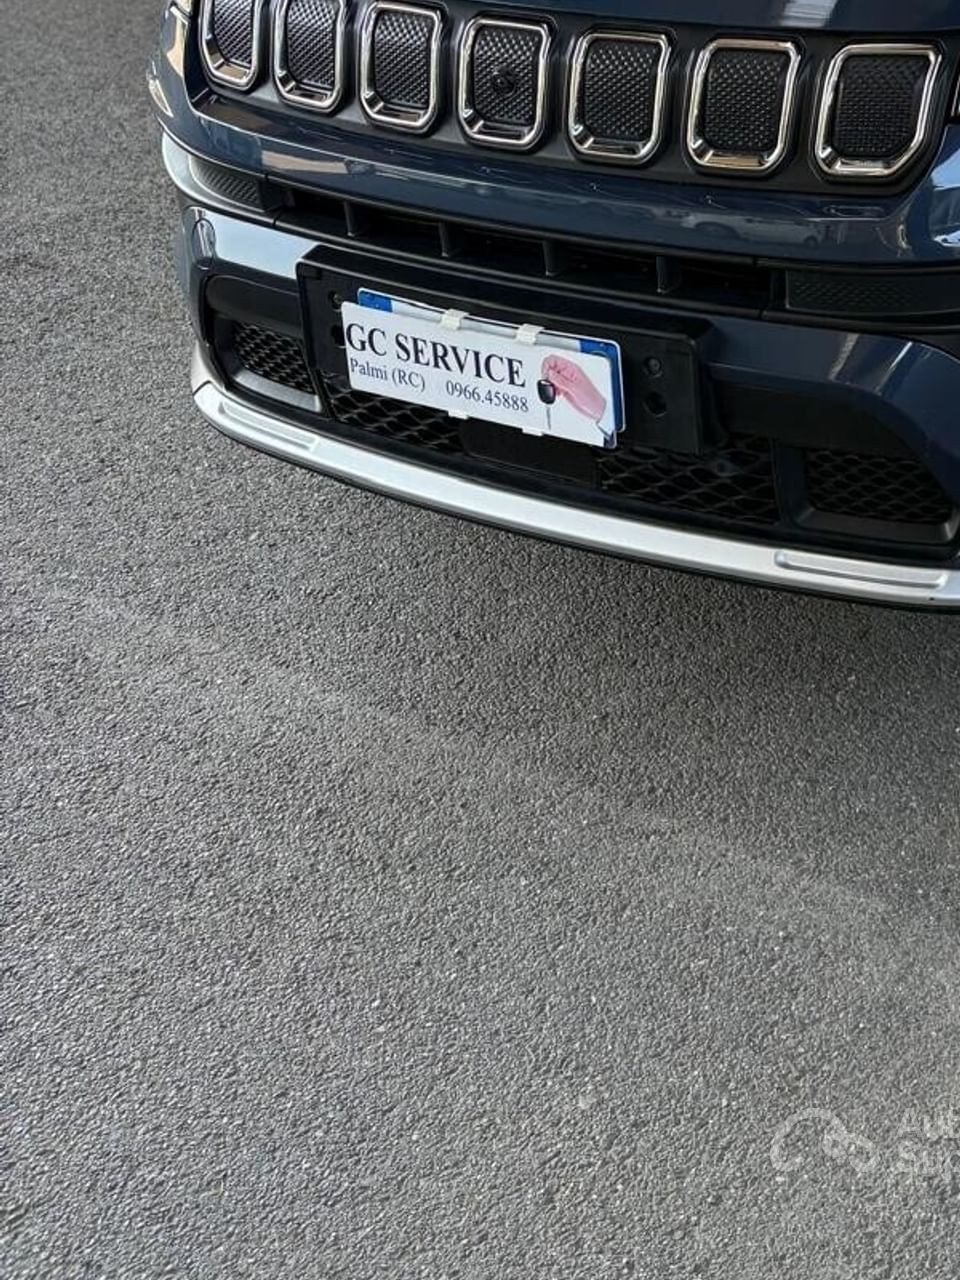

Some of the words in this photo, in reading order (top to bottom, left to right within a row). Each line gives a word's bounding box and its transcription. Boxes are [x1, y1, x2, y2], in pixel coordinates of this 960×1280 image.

[345, 322, 388, 357] GC
[395, 333, 527, 387] SERVICE
[350, 357, 389, 381] Palmi
[393, 367, 427, 393] (RC)
[446, 379, 529, 412] 0966.45888
